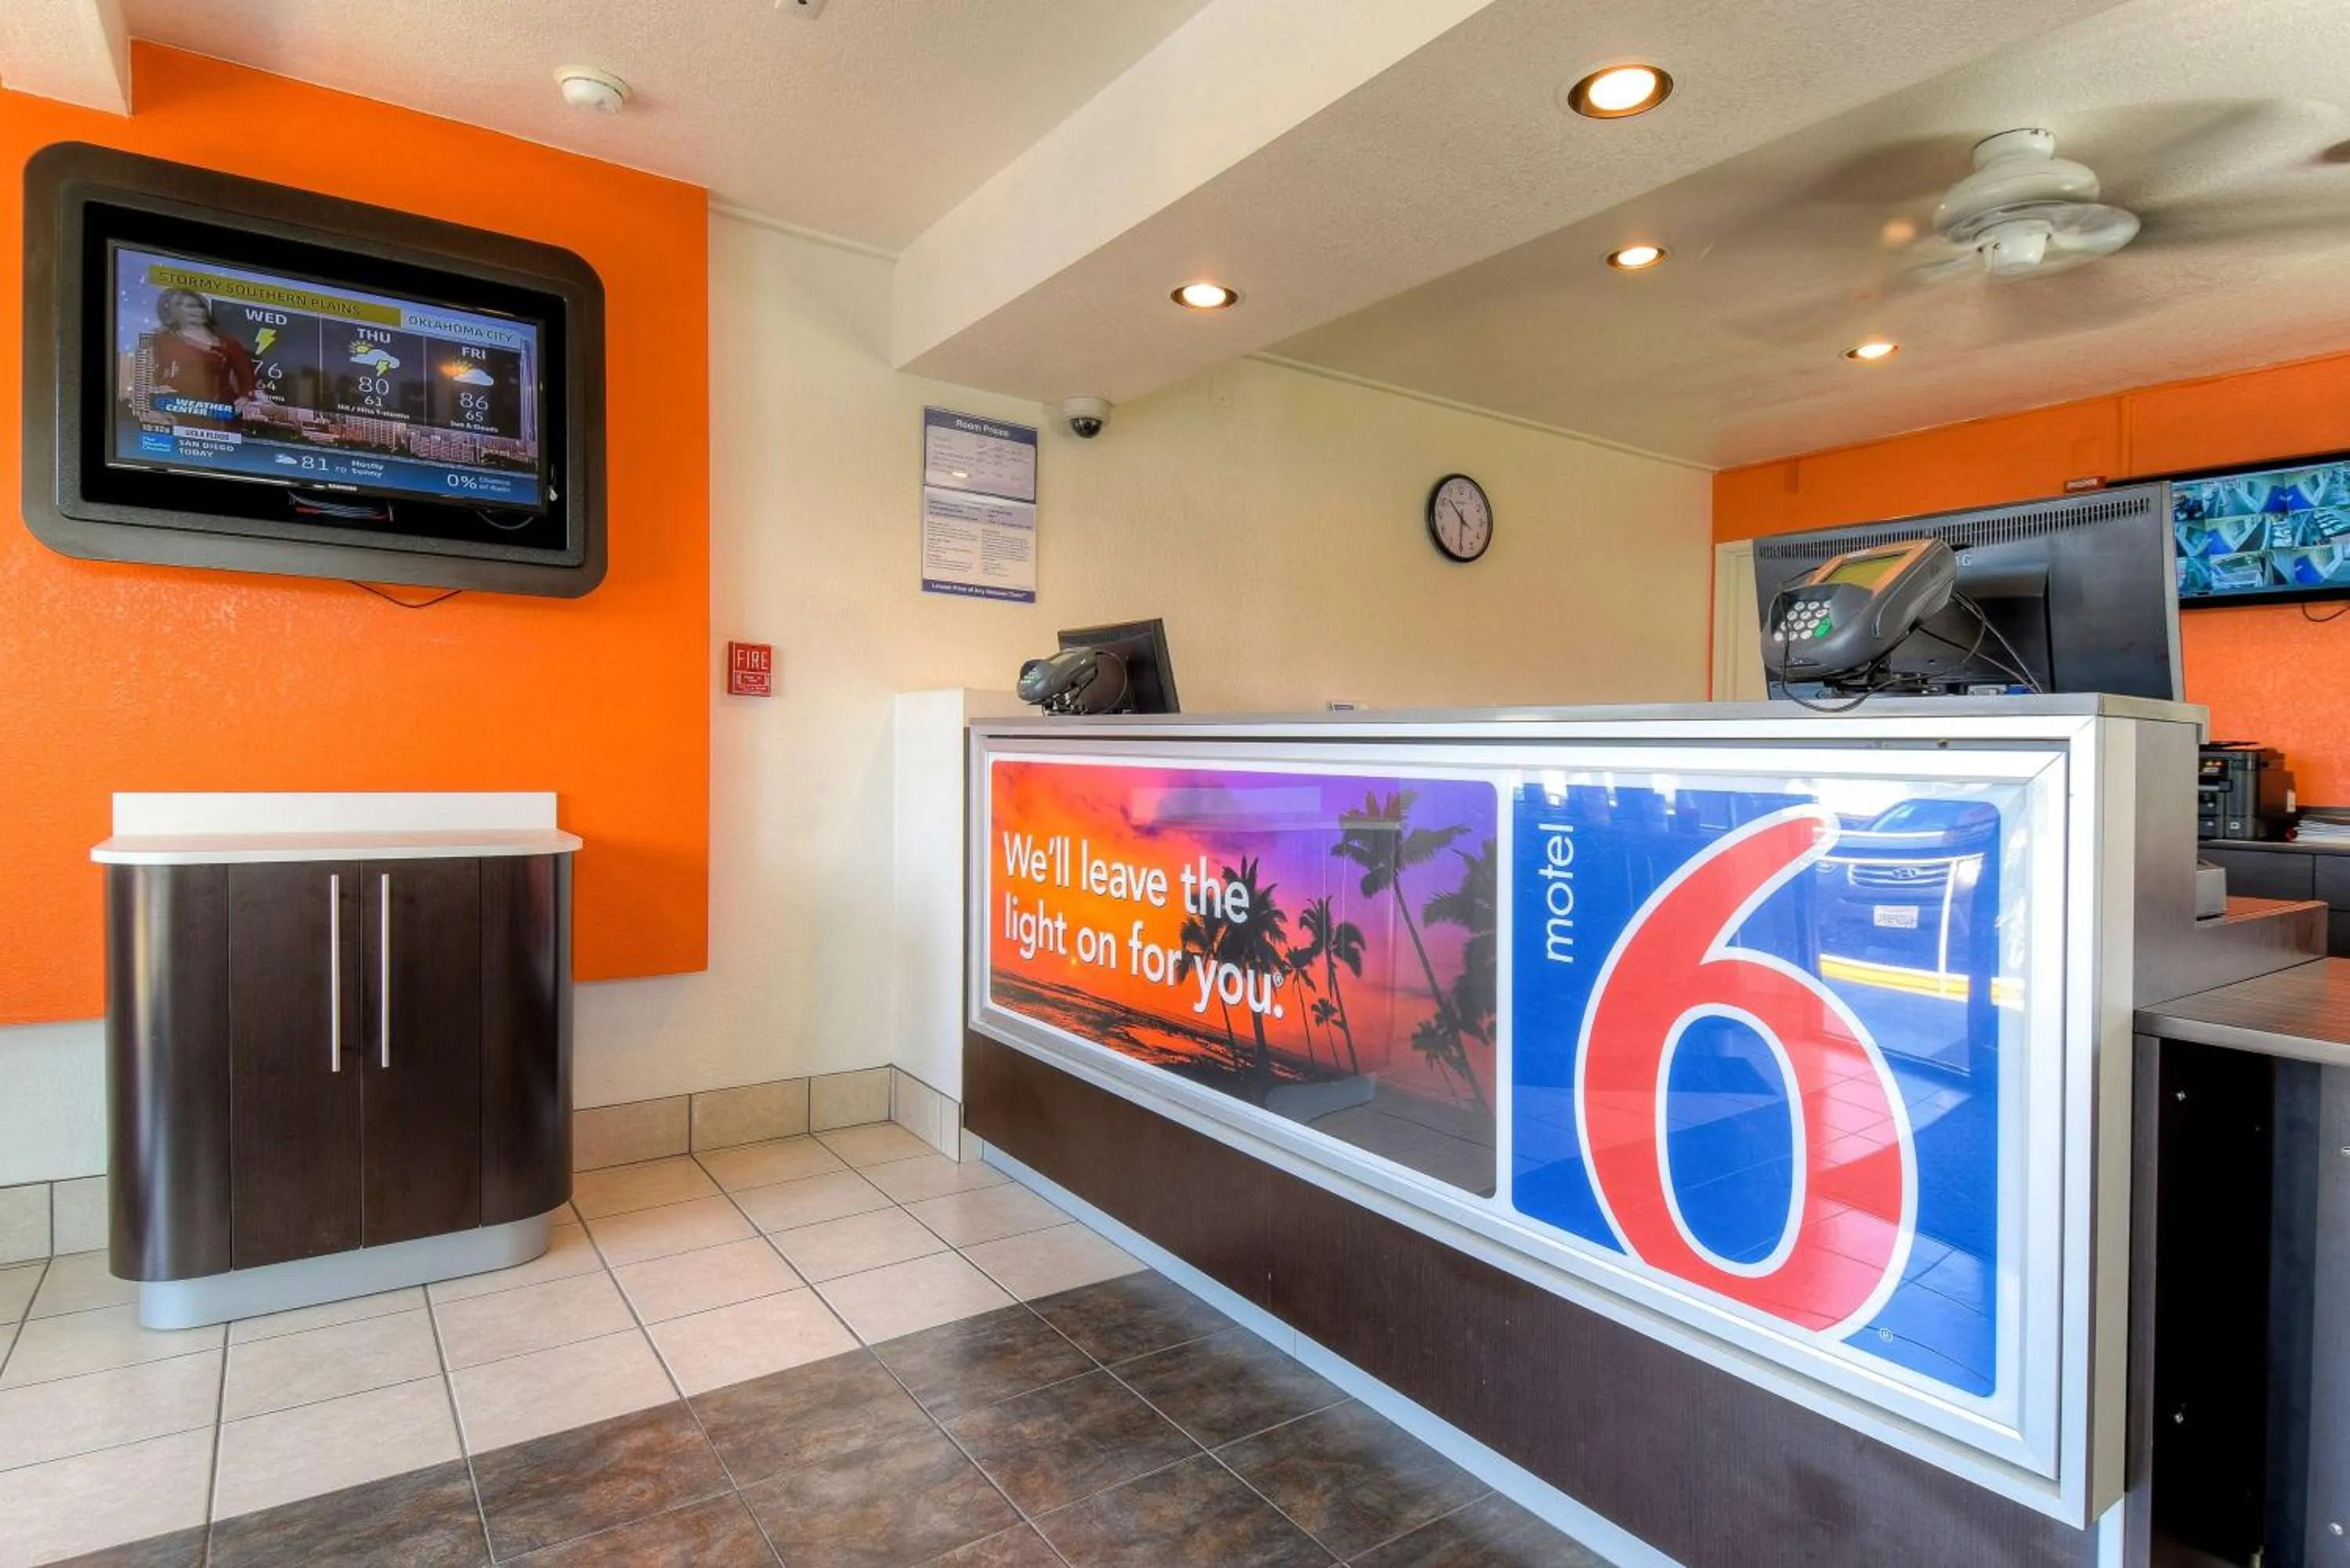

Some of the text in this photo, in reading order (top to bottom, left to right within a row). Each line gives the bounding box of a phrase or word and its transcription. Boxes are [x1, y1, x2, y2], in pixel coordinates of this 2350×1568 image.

[158, 271, 361, 314] STORMY SOUTHERN PLAINS
[244, 309, 287, 325] WED
[357, 327, 392, 343] THU
[408, 315, 513, 342] OKLAHOMA CITY
[461, 346, 486, 360] FRI
[251, 358, 283, 379] 76
[358, 376, 389, 396] 80
[175, 397, 233, 413] WEATHER
[364, 396, 382, 406] 61
[460, 392, 489, 410] 86
[165, 403, 208, 417] CENTER
[465, 411, 484, 422] 65
[179, 447, 214, 457] TODAY
[202, 443, 235, 452] DIEGO
[301, 456, 329, 471] 81
[447, 474, 477, 490] 0%
[737, 649, 768, 670] FIRE
[1081, 839, 1168, 907] leave
[1180, 855, 1249, 924] the
[1538, 823, 1574, 963] motel
[1004, 892, 1068, 959] light
[1076, 927, 1116, 969] on
[1128, 920, 1181, 986] for
[1574, 803, 1919, 1343] 6
